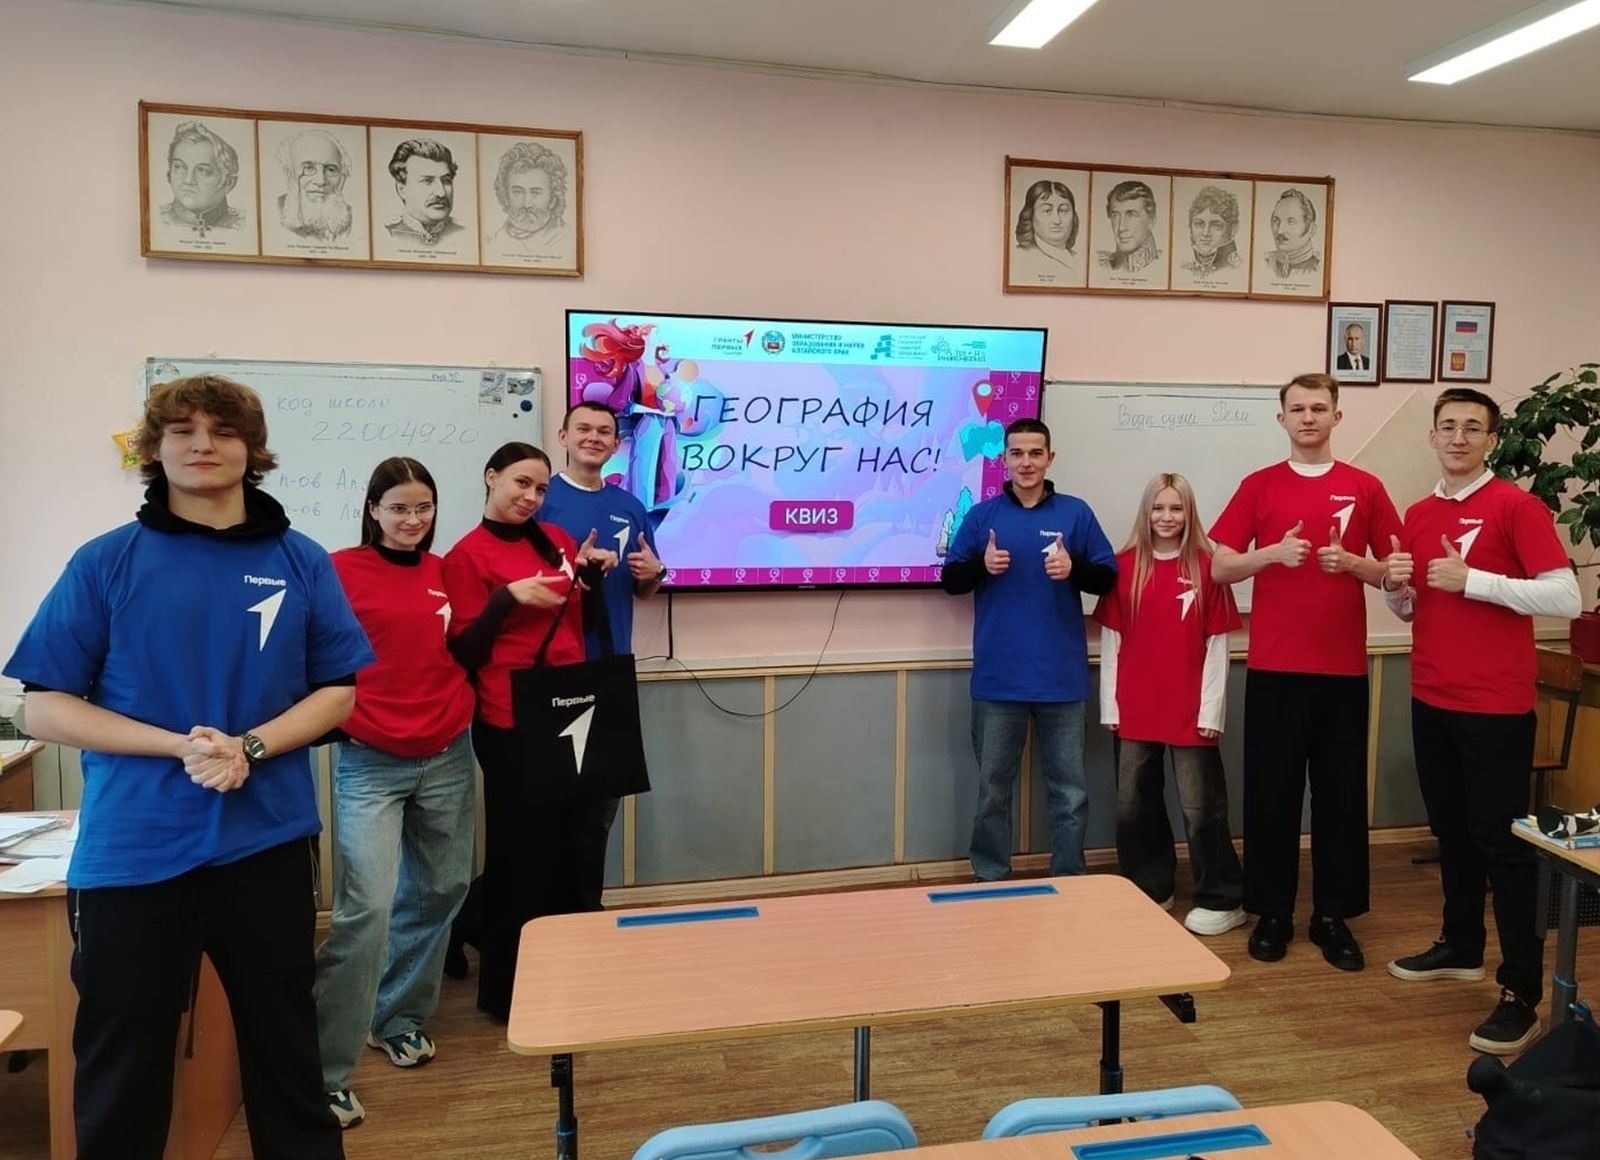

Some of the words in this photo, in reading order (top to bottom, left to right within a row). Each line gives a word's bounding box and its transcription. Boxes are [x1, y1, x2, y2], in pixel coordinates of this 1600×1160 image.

[791, 333, 842, 341] МИНИСТЕРСТВО
[693, 394, 934, 428] ГЕОГРАФИЯ
[311, 420, 479, 447] 22004920
[681, 443, 844, 473] ВОКРУГ
[856, 447, 942, 474] НАС!
[785, 508, 838, 525] КВИЗ
[243, 574, 286, 587] Первые
[551, 694, 596, 707] Первые
